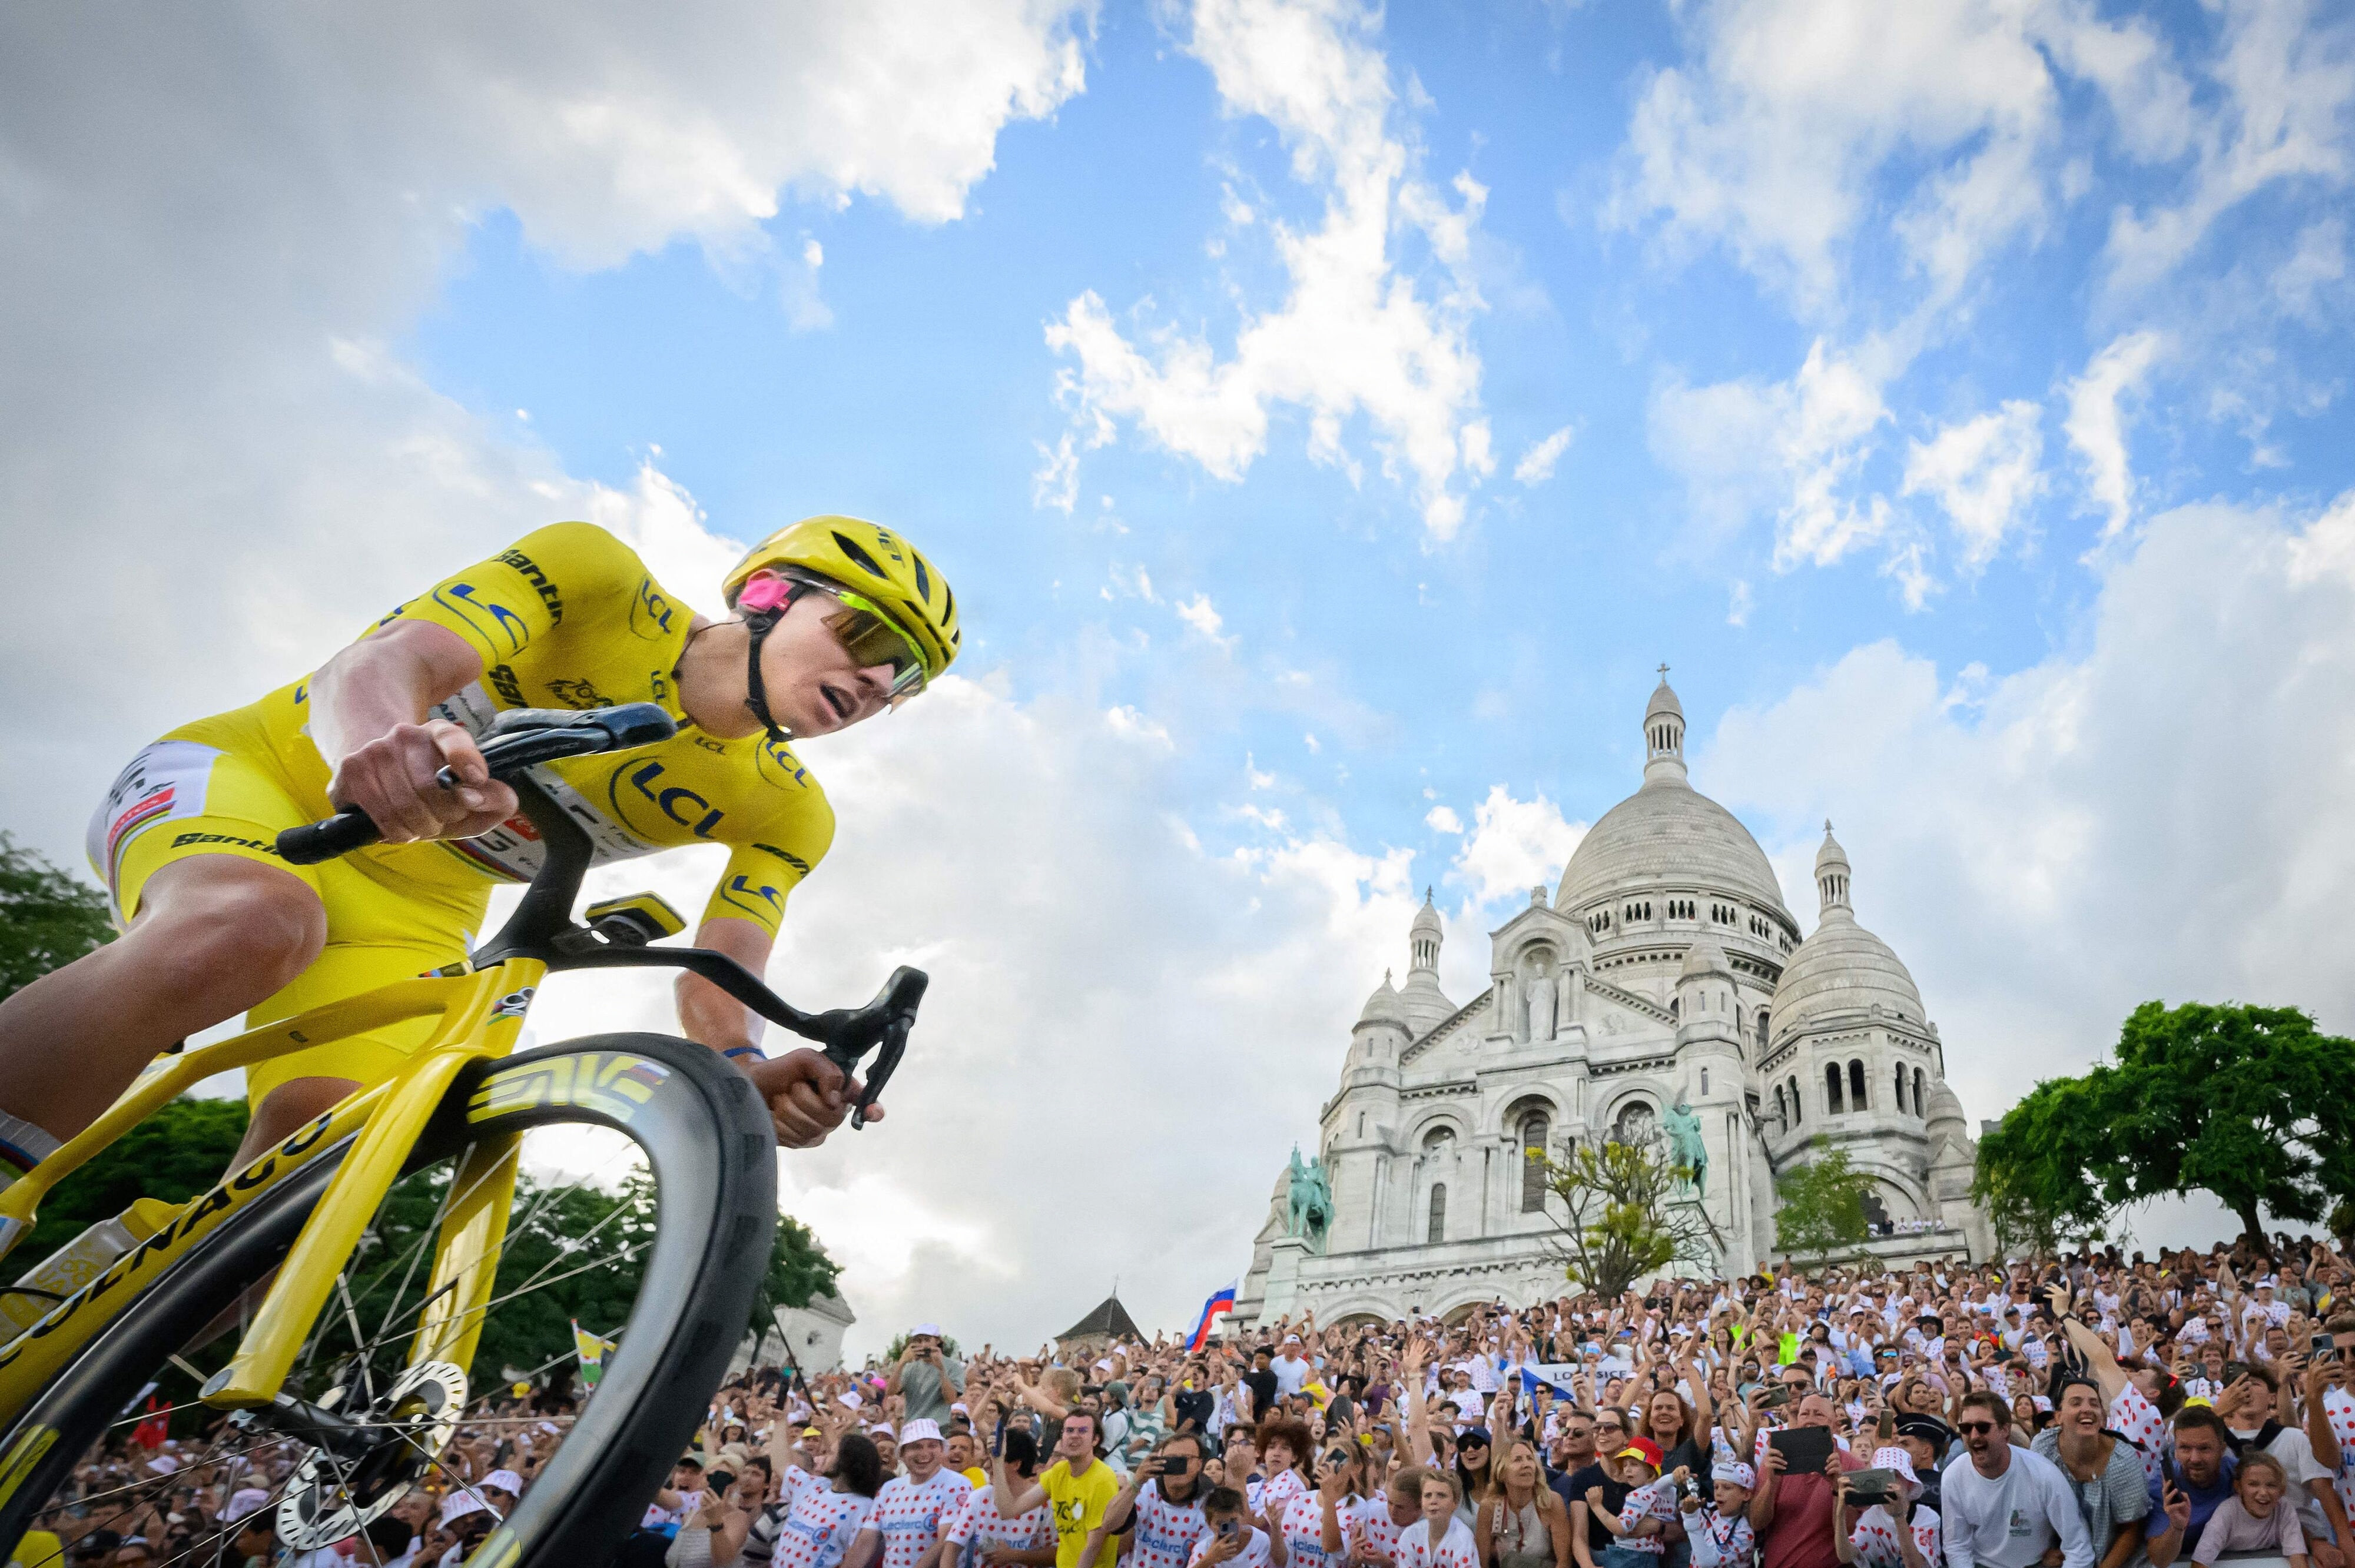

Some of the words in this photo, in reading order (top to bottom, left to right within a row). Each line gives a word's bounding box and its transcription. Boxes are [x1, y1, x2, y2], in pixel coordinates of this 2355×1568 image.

[642, 579, 672, 634] LCL
[695, 737, 725, 756] LCL
[766, 739, 808, 789] LCL
[631, 762, 724, 839] LCL
